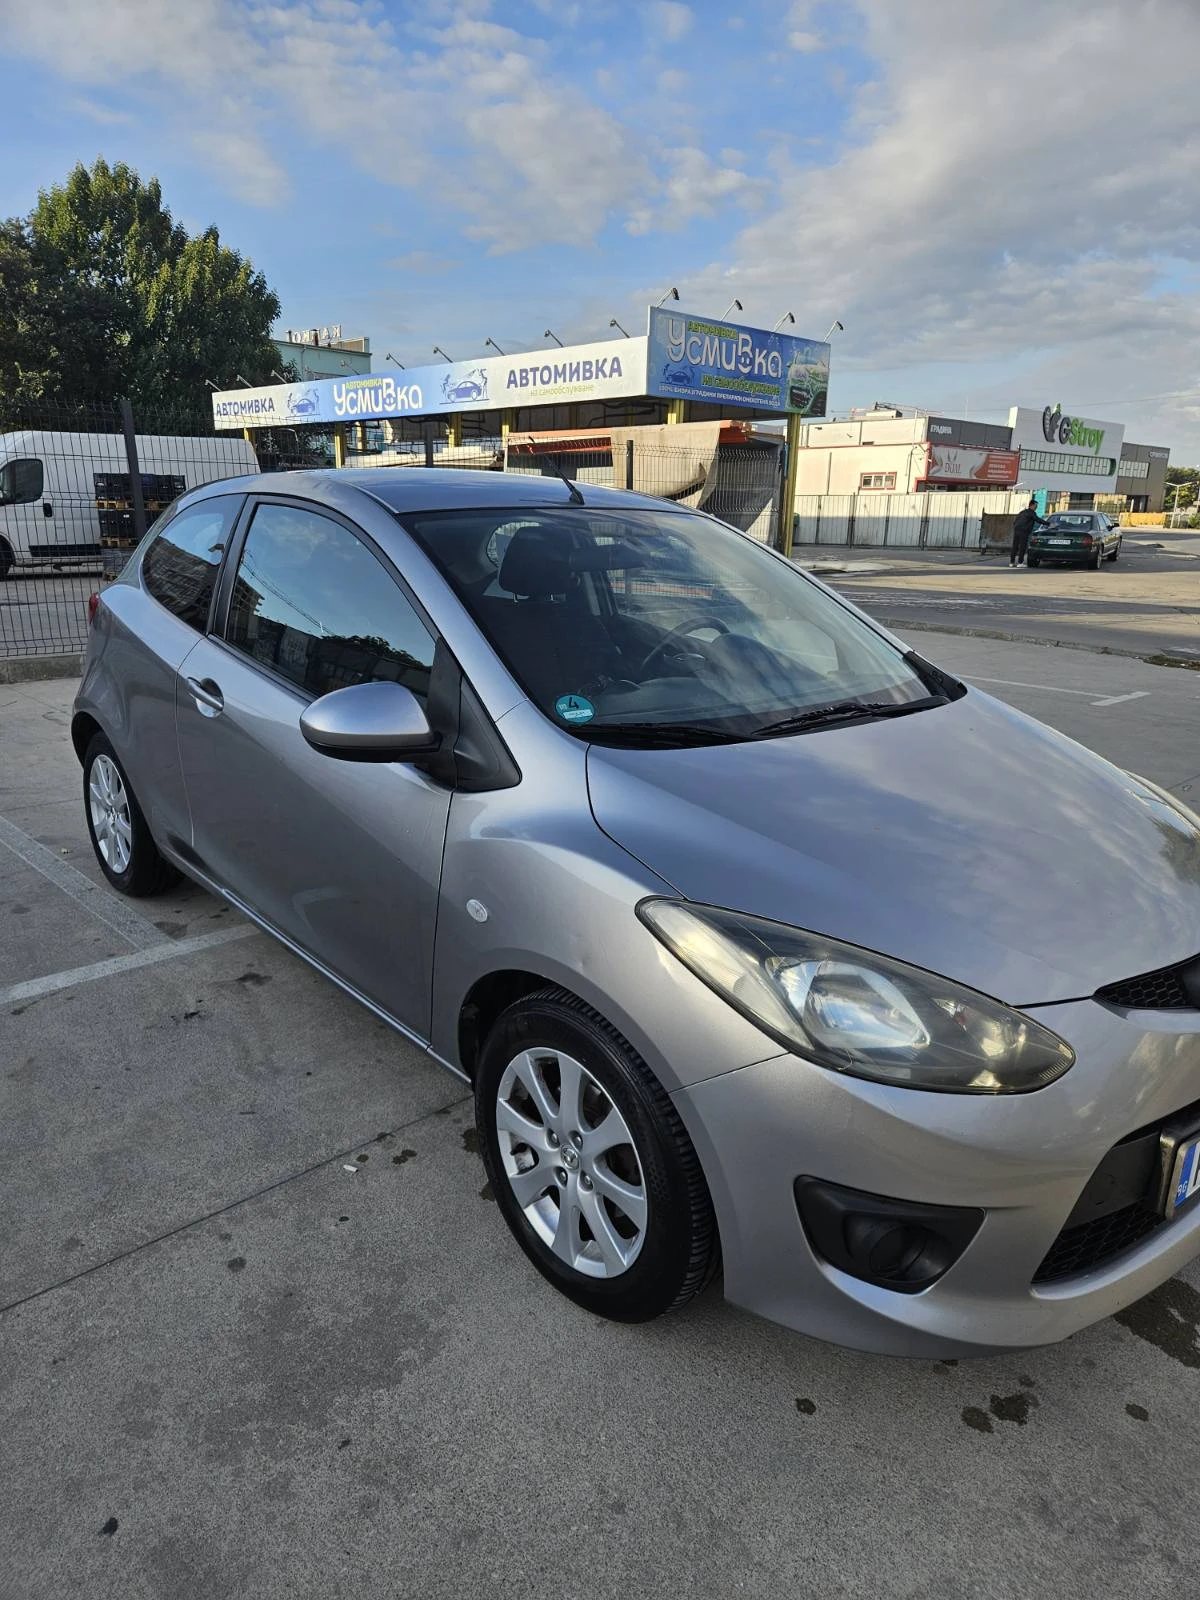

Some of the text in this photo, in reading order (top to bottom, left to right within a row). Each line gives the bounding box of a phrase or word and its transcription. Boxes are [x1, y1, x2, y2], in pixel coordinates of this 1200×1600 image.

[507, 356, 622, 389] АВТОМИВКА
[345, 378, 382, 389] АВТОМИВКА
[216, 397, 275, 416] АВТОМИВКА
[1059, 416, 1105, 455] GStroy
[568, 696, 580, 708] 4
[1177, 1180, 1188, 1198] BG
